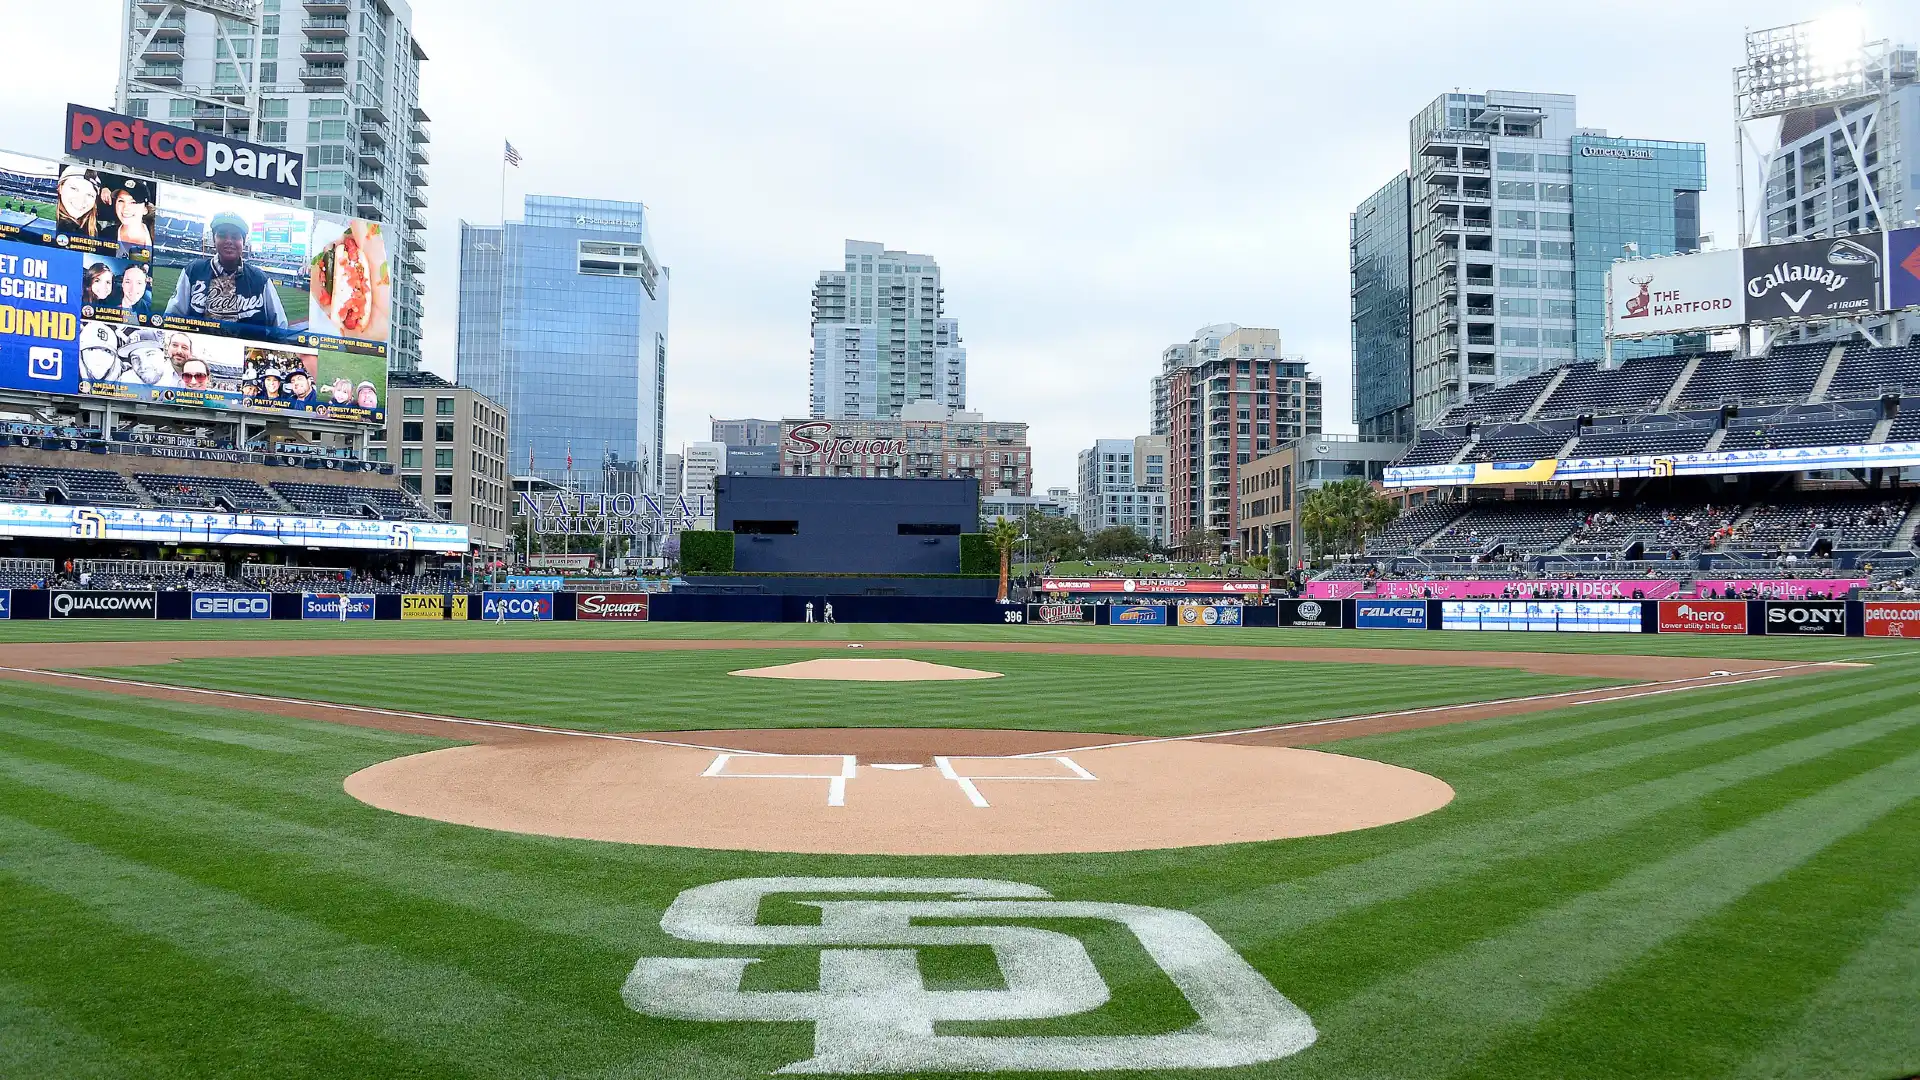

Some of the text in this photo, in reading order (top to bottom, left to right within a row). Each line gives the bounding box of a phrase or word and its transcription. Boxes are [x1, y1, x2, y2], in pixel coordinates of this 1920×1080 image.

[1630, 148, 1654, 158] Bank
[205, 140, 299, 187] park
[23, 257, 48, 279] ON
[1748, 261, 1847, 298] Callaway
[0, 276, 68, 304] SCREEN
[1653, 290, 1680, 302] THE
[96, 306, 120, 315] LAUREN
[1653, 298, 1732, 316] HARTFORD
[1827, 299, 1869, 310] #1 IRONS
[164, 316, 185, 325] JAVIER
[787, 421, 908, 465] Sycuan
[152, 447, 238, 461] ESTRELLA LANDING
[517, 491, 714, 518] NATIONAL
[533, 516, 698, 536] UNIVERSITY
[1058, 581, 1091, 589] QUIKSILVER
[1160, 579, 1186, 587] DIEGO
[1583, 582, 1622, 595] DECK
[54, 593, 152, 616] QUALCOMM
[195, 598, 268, 613] GEICO
[403, 597, 465, 609] STANLY
[584, 595, 642, 617] Sycuan
[1303, 605, 1316, 613] FOX
[1004, 610, 1023, 623] 396
[1040, 605, 1084, 623] CHOLULA
[1120, 611, 1157, 624] ampm
[1359, 607, 1424, 617] FALKEN
[1689, 607, 1725, 621] hero
[1768, 608, 1845, 623] SONY
[1684, 622, 1704, 630] utility
